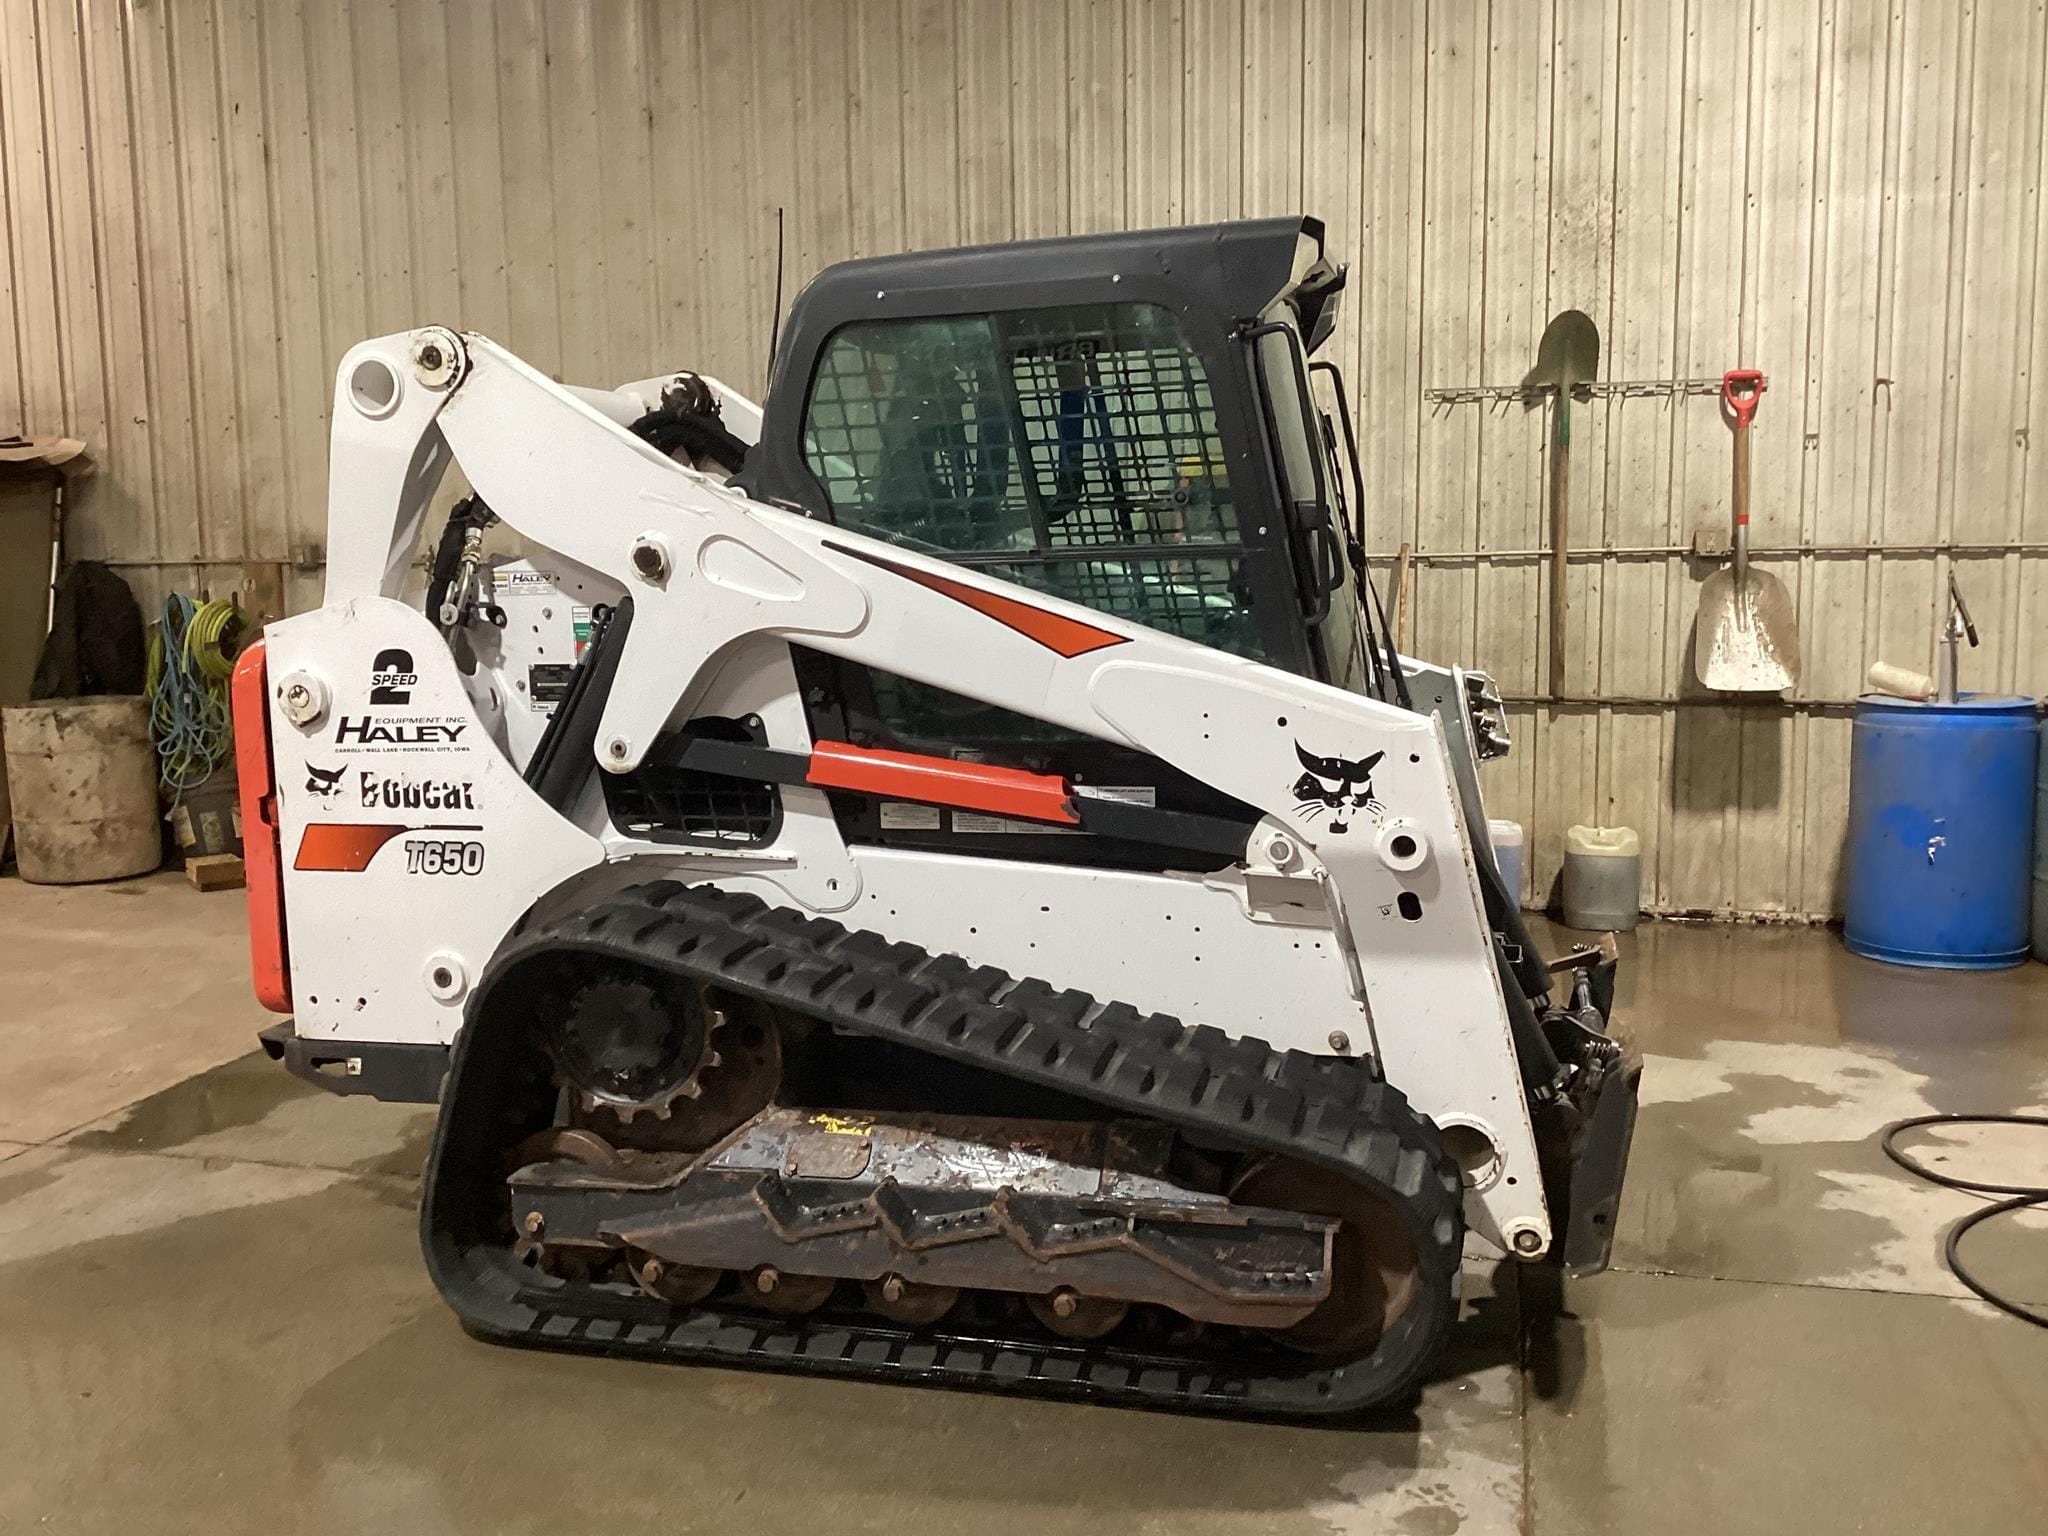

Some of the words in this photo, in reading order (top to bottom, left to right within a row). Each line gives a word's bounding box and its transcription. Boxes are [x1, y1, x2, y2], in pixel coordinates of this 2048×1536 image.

[369, 648, 414, 705] 2
[371, 674, 418, 686] SPEED
[335, 715, 468, 744] HALEY
[374, 716, 442, 725] EQUIPMENT
[445, 716, 468, 724] INC.
[404, 840, 485, 876] T650
